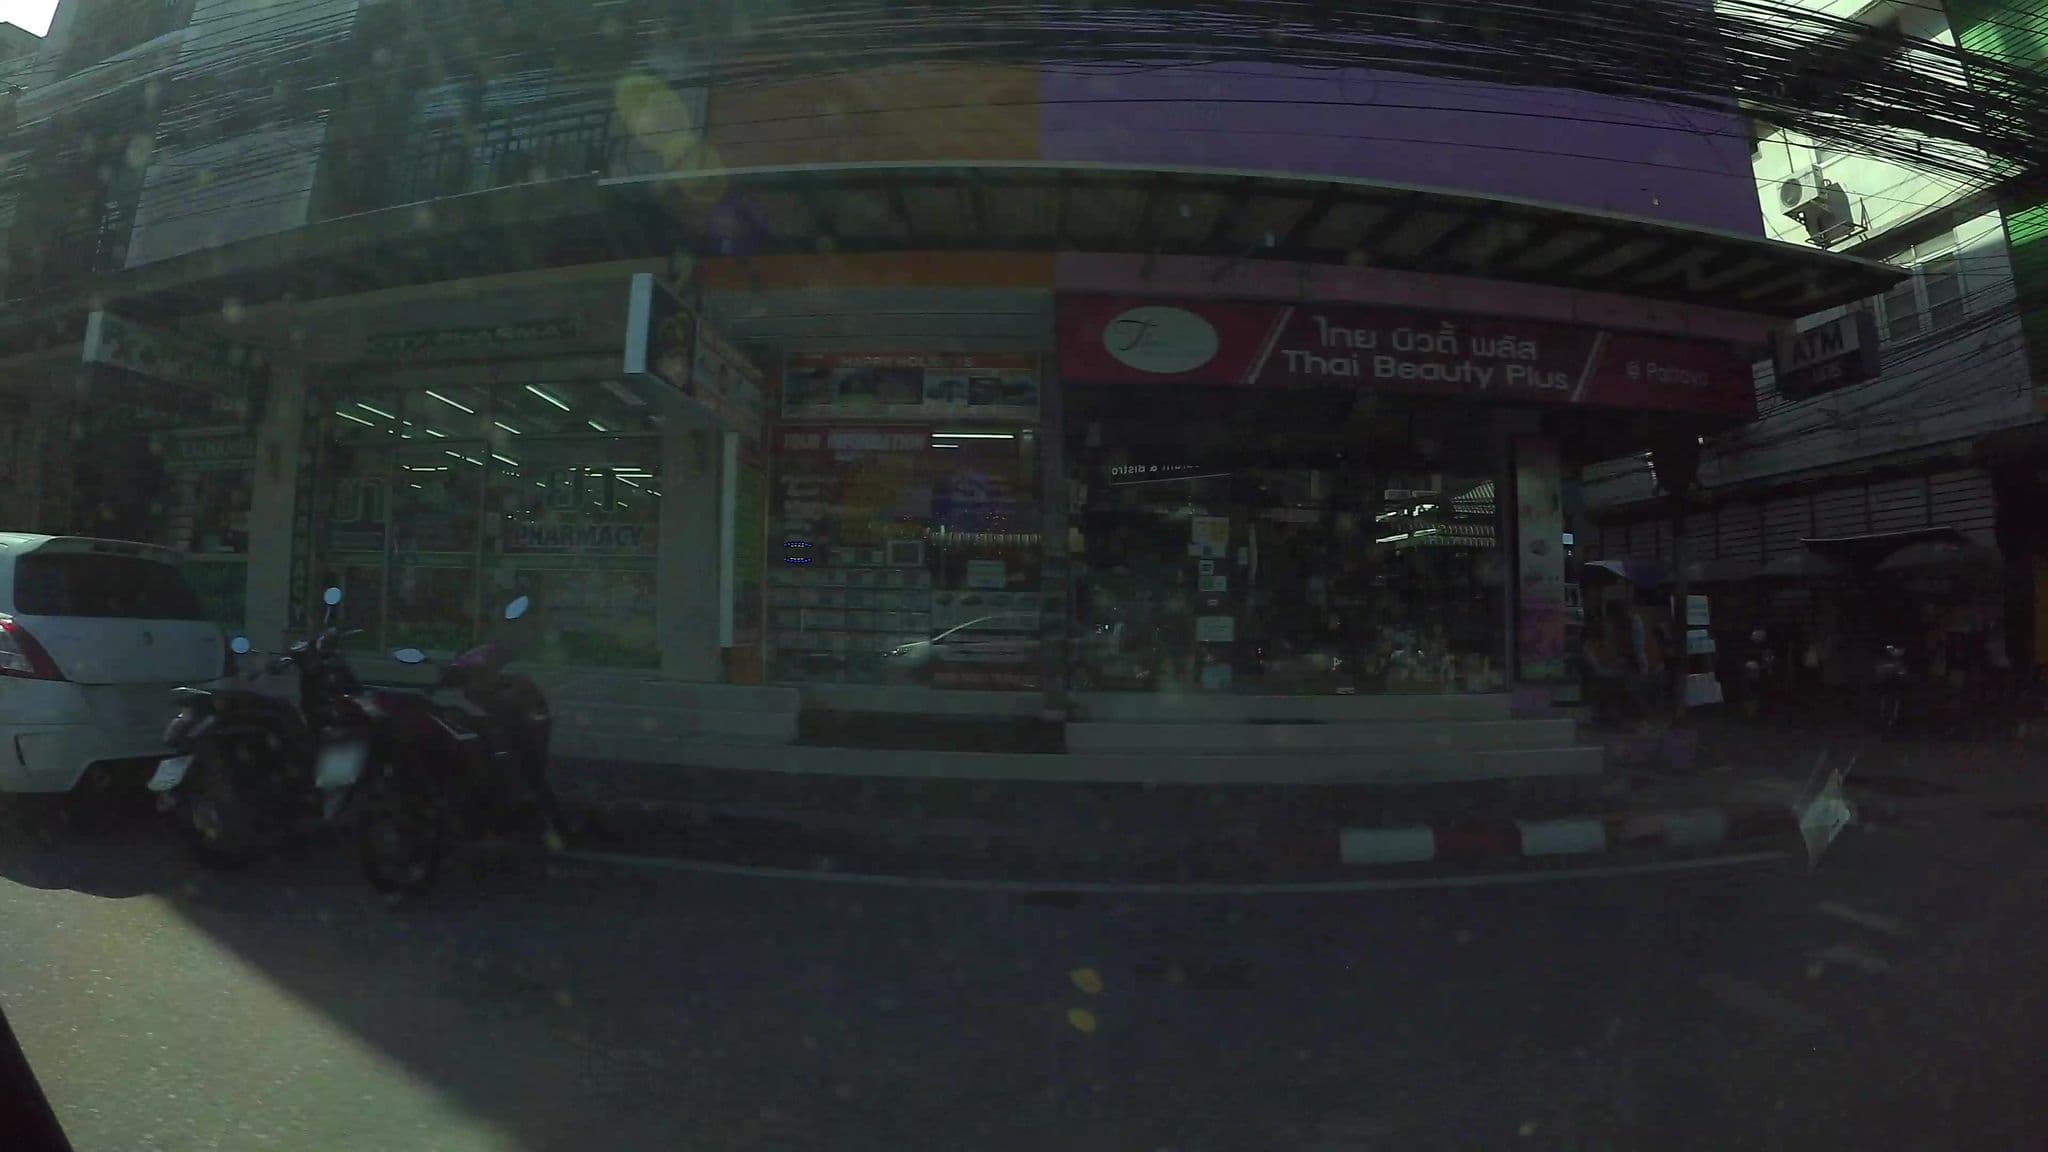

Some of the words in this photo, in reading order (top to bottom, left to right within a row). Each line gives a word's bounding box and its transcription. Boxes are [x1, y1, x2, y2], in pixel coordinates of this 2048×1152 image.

[1311, 314, 1376, 349] ไทย
[1471, 334, 1537, 361] พลัส
[1792, 321, 1844, 365] ATM
[1281, 349, 1360, 377] Thai
[1373, 355, 1494, 390] Beauty
[1505, 363, 1569, 391] Plus
[512, 524, 645, 547] PHARMACY
